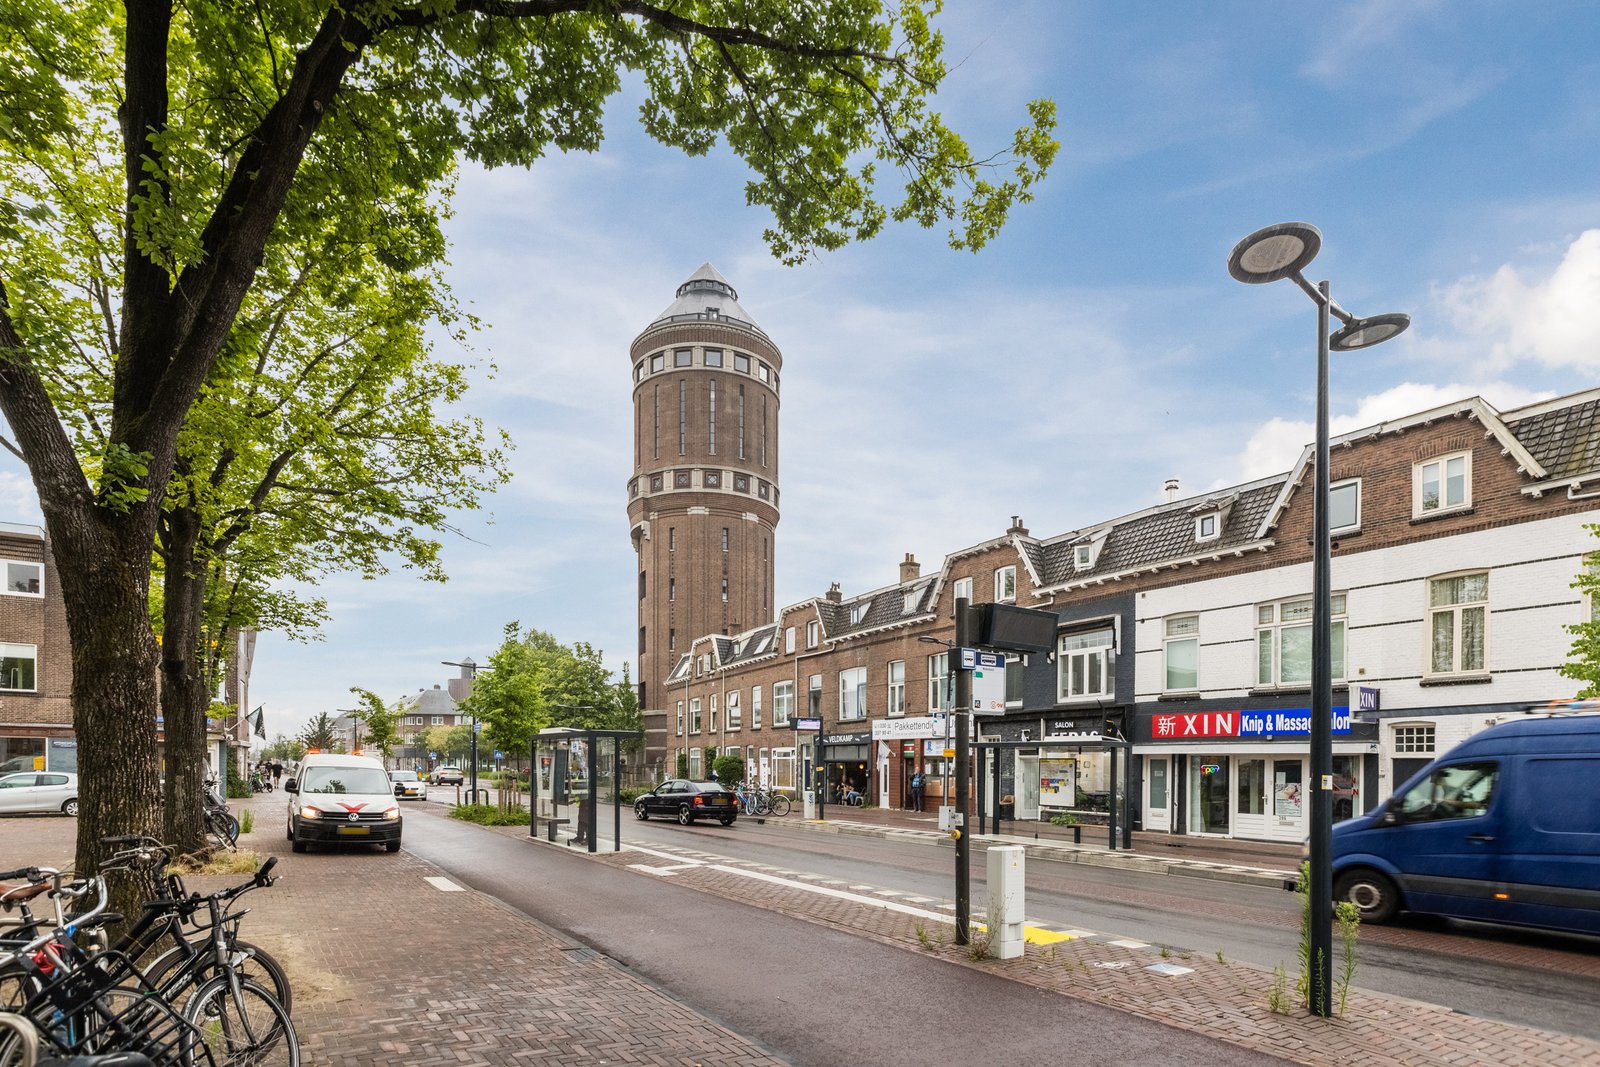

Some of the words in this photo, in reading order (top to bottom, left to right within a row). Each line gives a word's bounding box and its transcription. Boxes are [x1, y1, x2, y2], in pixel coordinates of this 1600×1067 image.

[1360, 692, 1375, 708] XIN
[894, 720, 934, 731] Pakkettendi
[1054, 721, 1074, 729] SALON
[1158, 716, 1176, 736] 新
[1183, 713, 1232, 735] XIN
[1242, 715, 1264, 735] Knip
[1265, 714, 1273, 731] &
[828, 734, 854, 743] VELDKAMP
